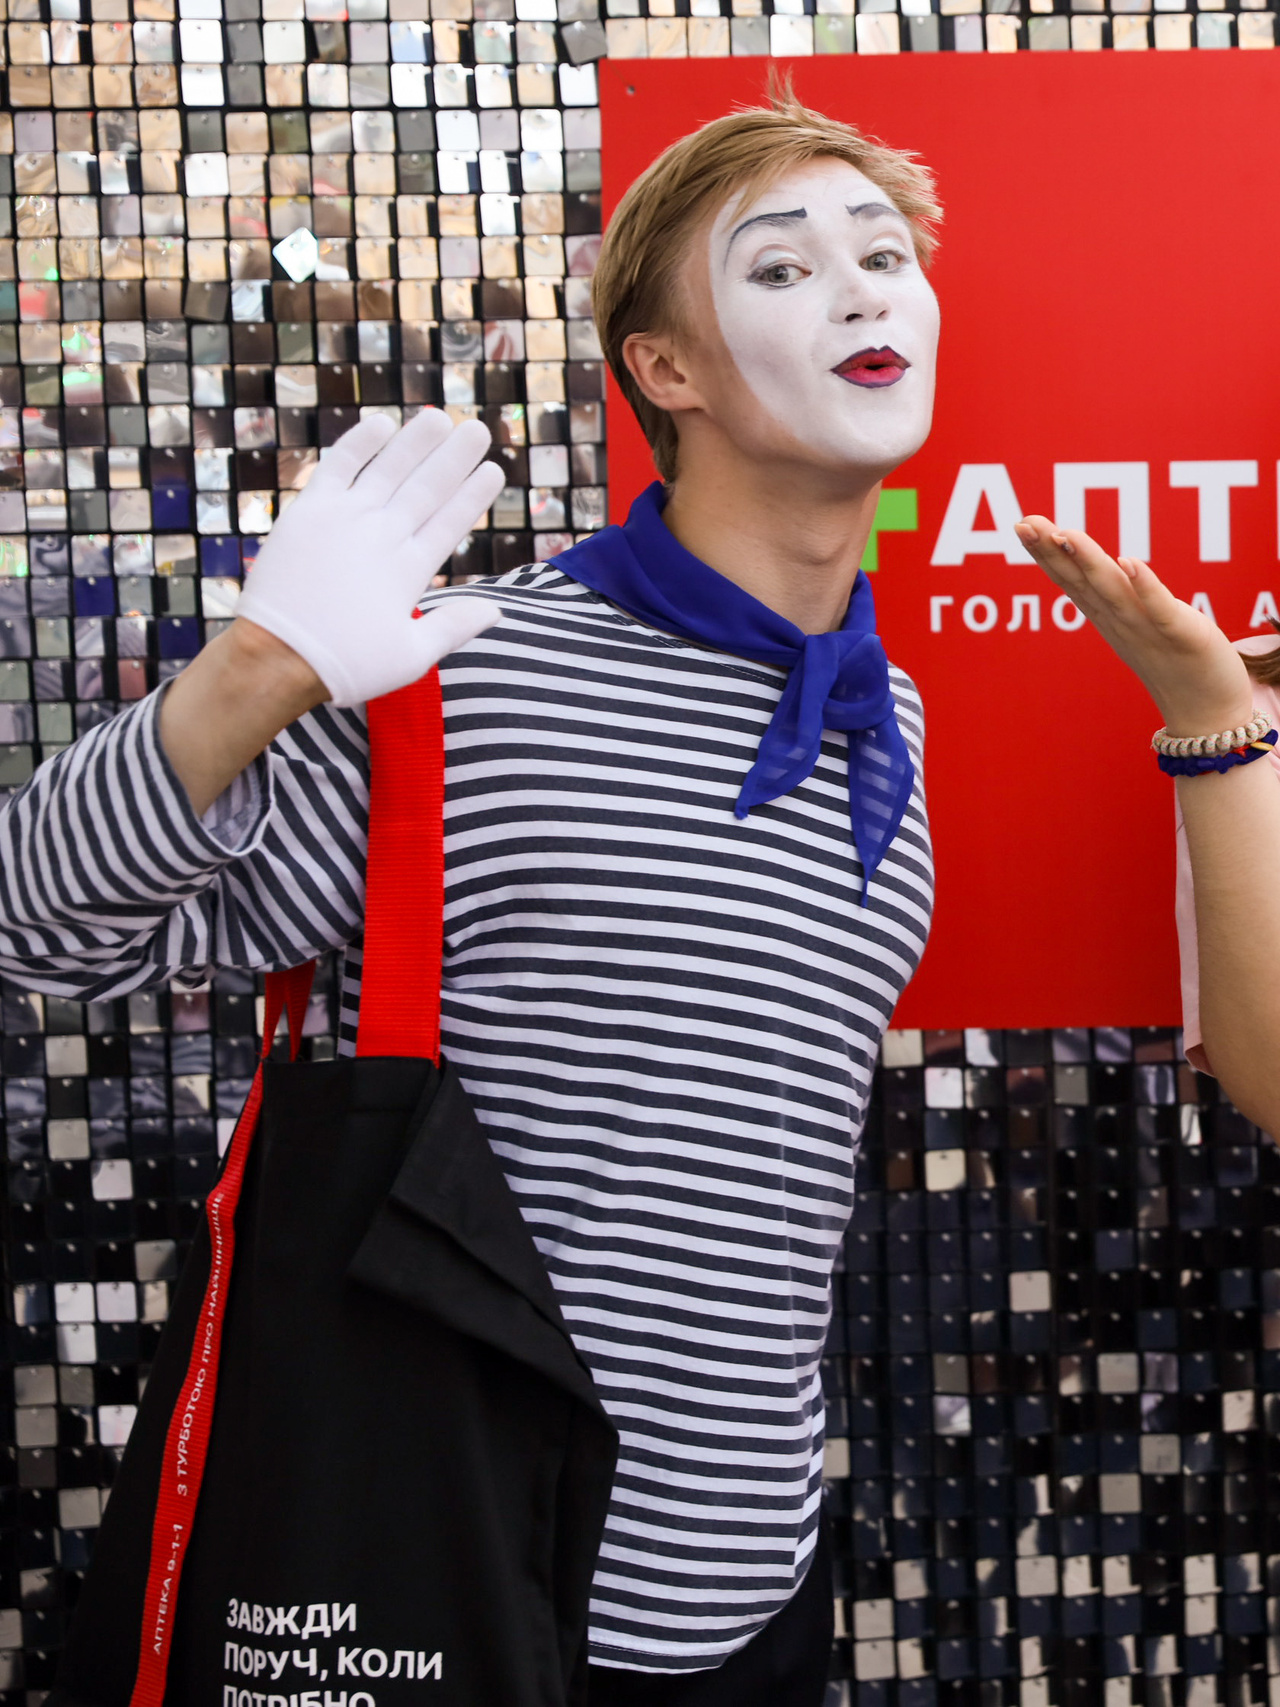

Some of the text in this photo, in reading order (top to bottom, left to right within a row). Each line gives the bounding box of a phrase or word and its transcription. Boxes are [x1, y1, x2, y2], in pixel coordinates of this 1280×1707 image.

[930, 592, 1217, 633] ГОЛОА
[177, 1368, 207, 1477] ТУРБОТОЮ
[202, 1322, 214, 1363] ПРО
[153, 1577, 173, 1655] АПТЕКА
[226, 1597, 358, 1640] ЗАВЖДИ
[223, 1641, 443, 1682] ПОРУЧ, КОЛИ
